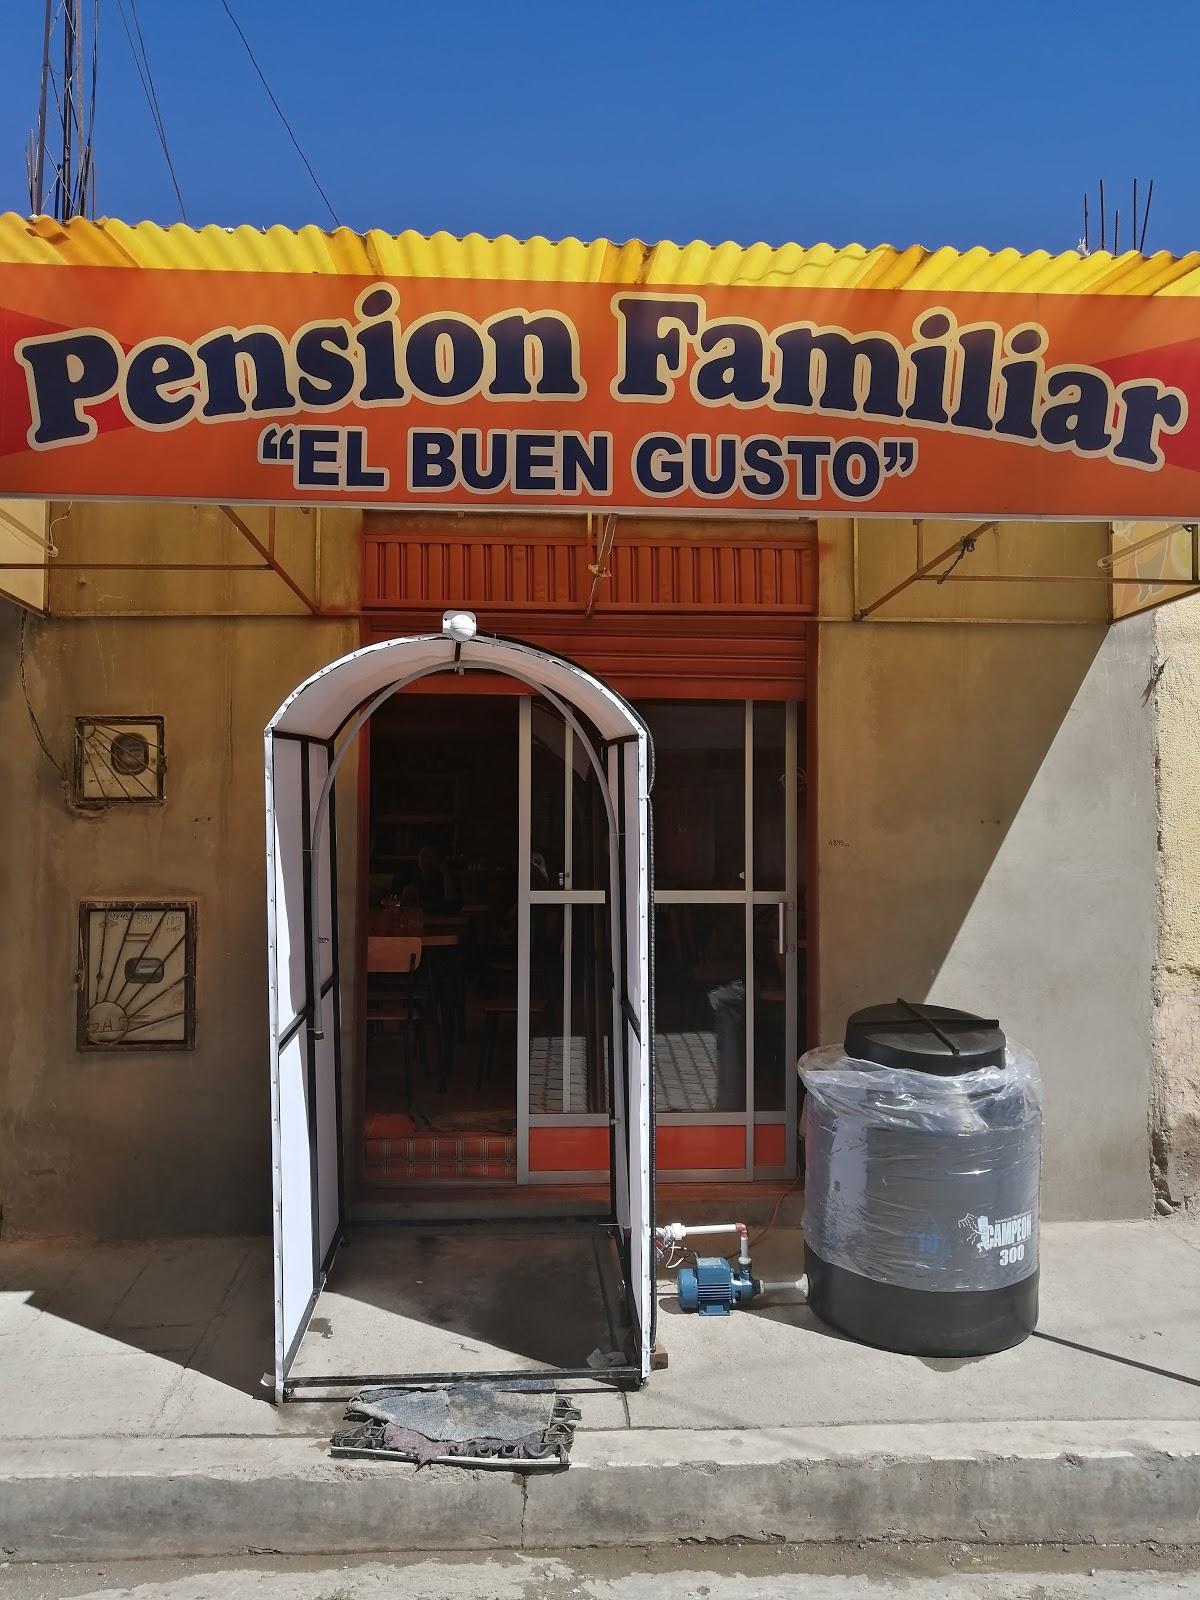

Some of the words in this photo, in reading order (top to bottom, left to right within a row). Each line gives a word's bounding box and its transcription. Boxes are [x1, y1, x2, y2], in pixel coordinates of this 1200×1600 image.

[20, 288, 582, 446] Pension
[616, 297, 1182, 467] Familiar
[410, 430, 610, 493] BUEN
[987, 1212, 1033, 1249] CAMPEON
[999, 1244, 1025, 1266] 300
